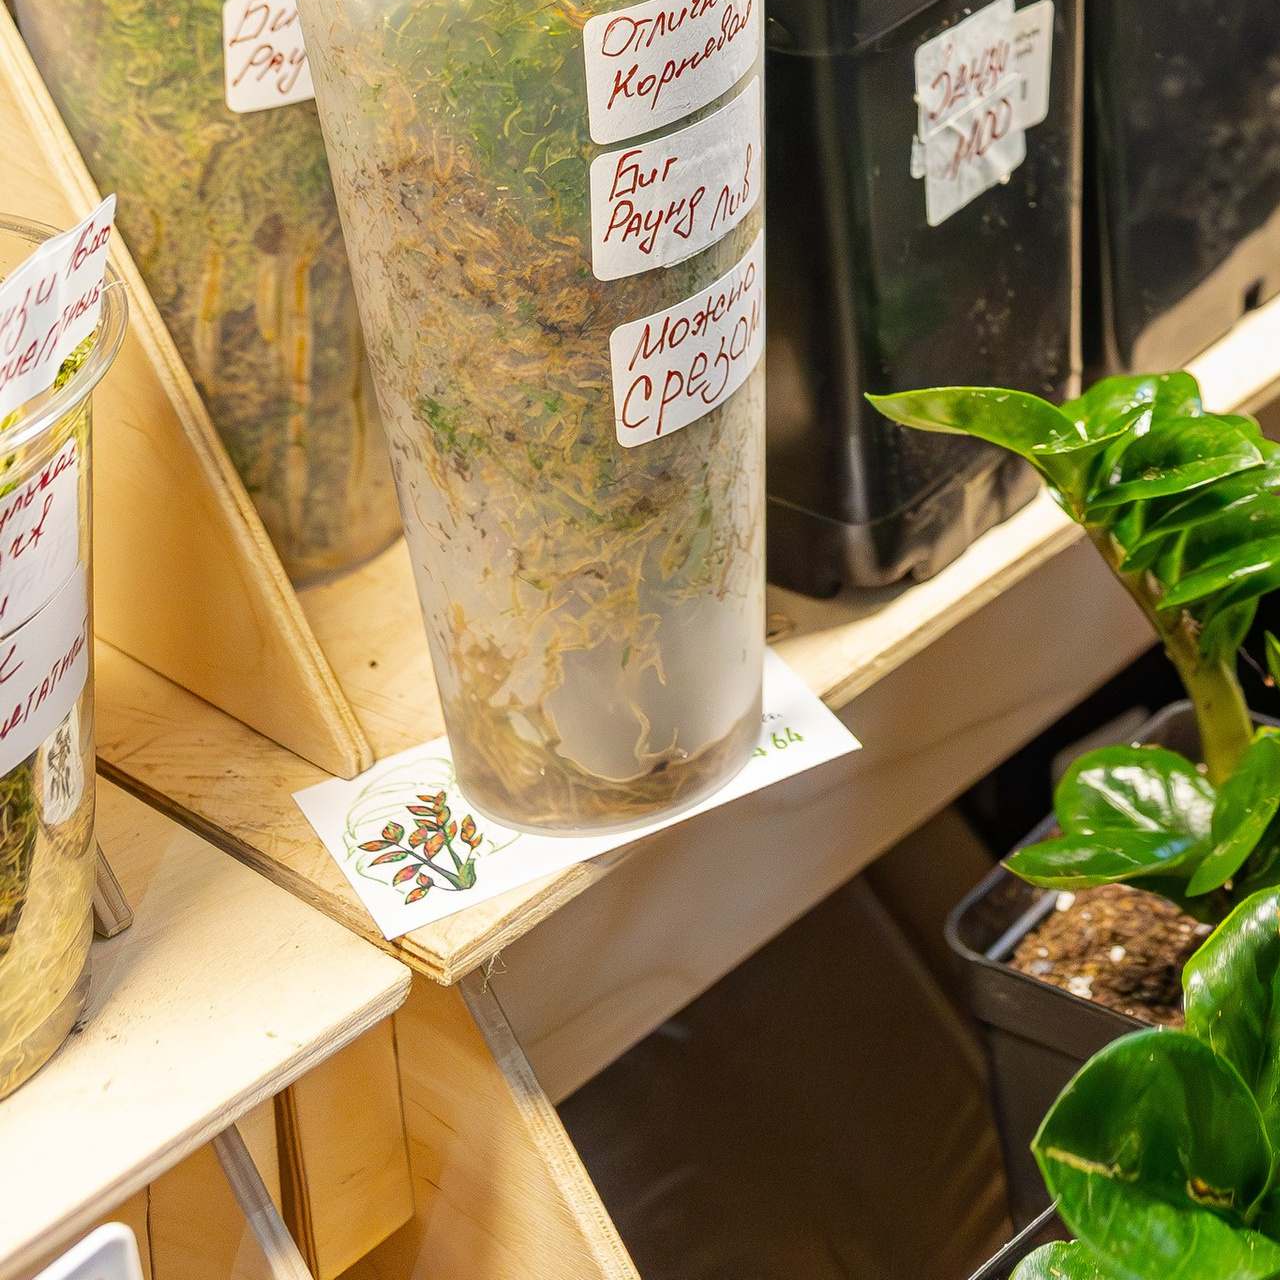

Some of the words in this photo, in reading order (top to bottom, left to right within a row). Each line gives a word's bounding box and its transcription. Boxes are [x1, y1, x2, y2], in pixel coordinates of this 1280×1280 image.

[607, 0, 753, 110] Корневая
[608, 149, 679, 203] Биг
[710, 142, 753, 232] Лив
[628, 261, 756, 372] Можно
